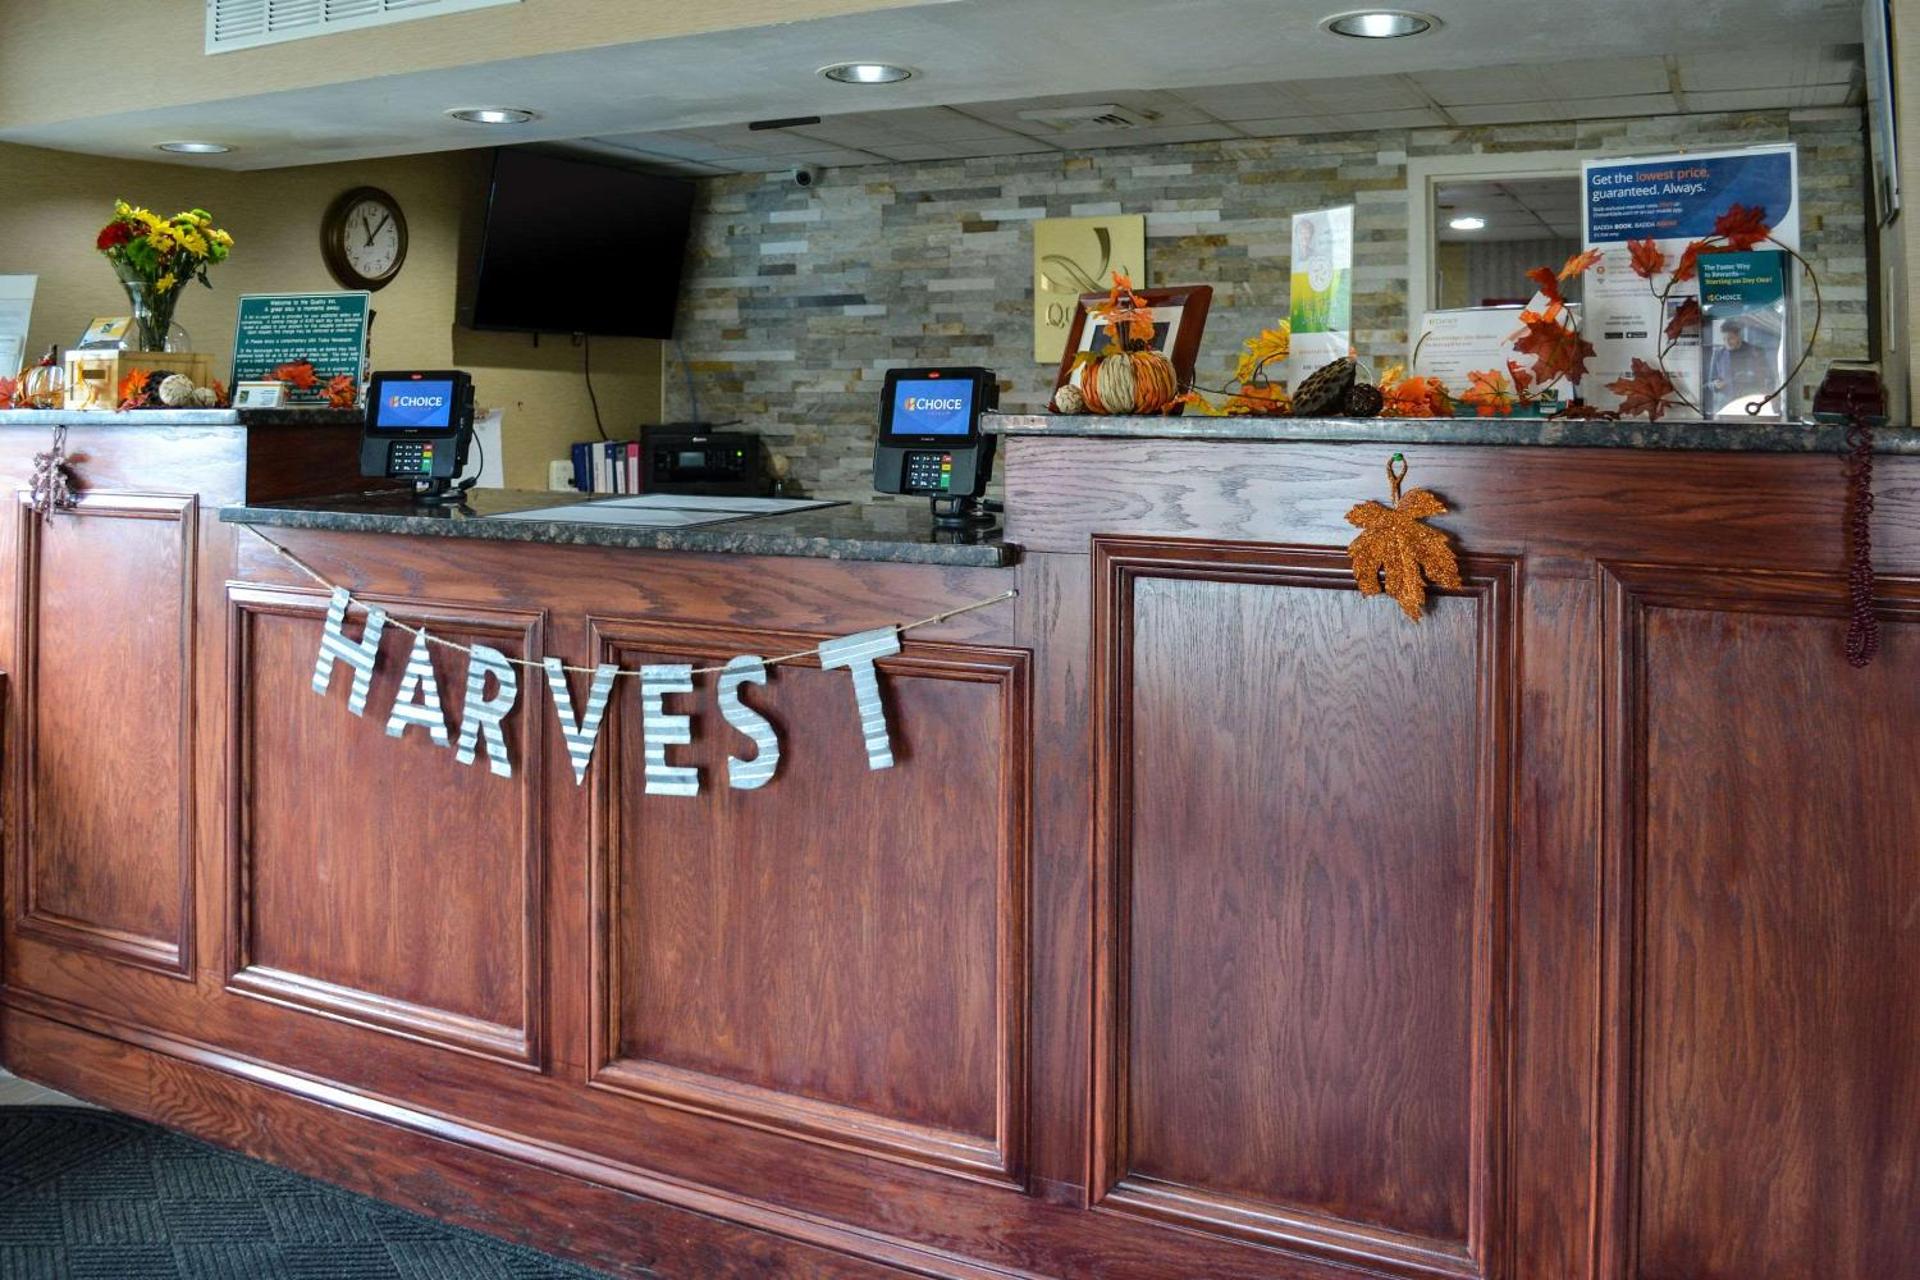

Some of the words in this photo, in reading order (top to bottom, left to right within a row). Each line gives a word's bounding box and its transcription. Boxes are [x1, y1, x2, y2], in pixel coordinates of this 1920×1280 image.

[1592, 174, 1612, 185] Get
[1615, 172, 1633, 183] the
[1636, 170, 1674, 182] lowest
[1592, 185, 1660, 202] guaranteed.
[400, 396, 443, 407] CHOICE
[916, 398, 962, 410] CHOICE
[311, 585, 901, 797] HARVEST
